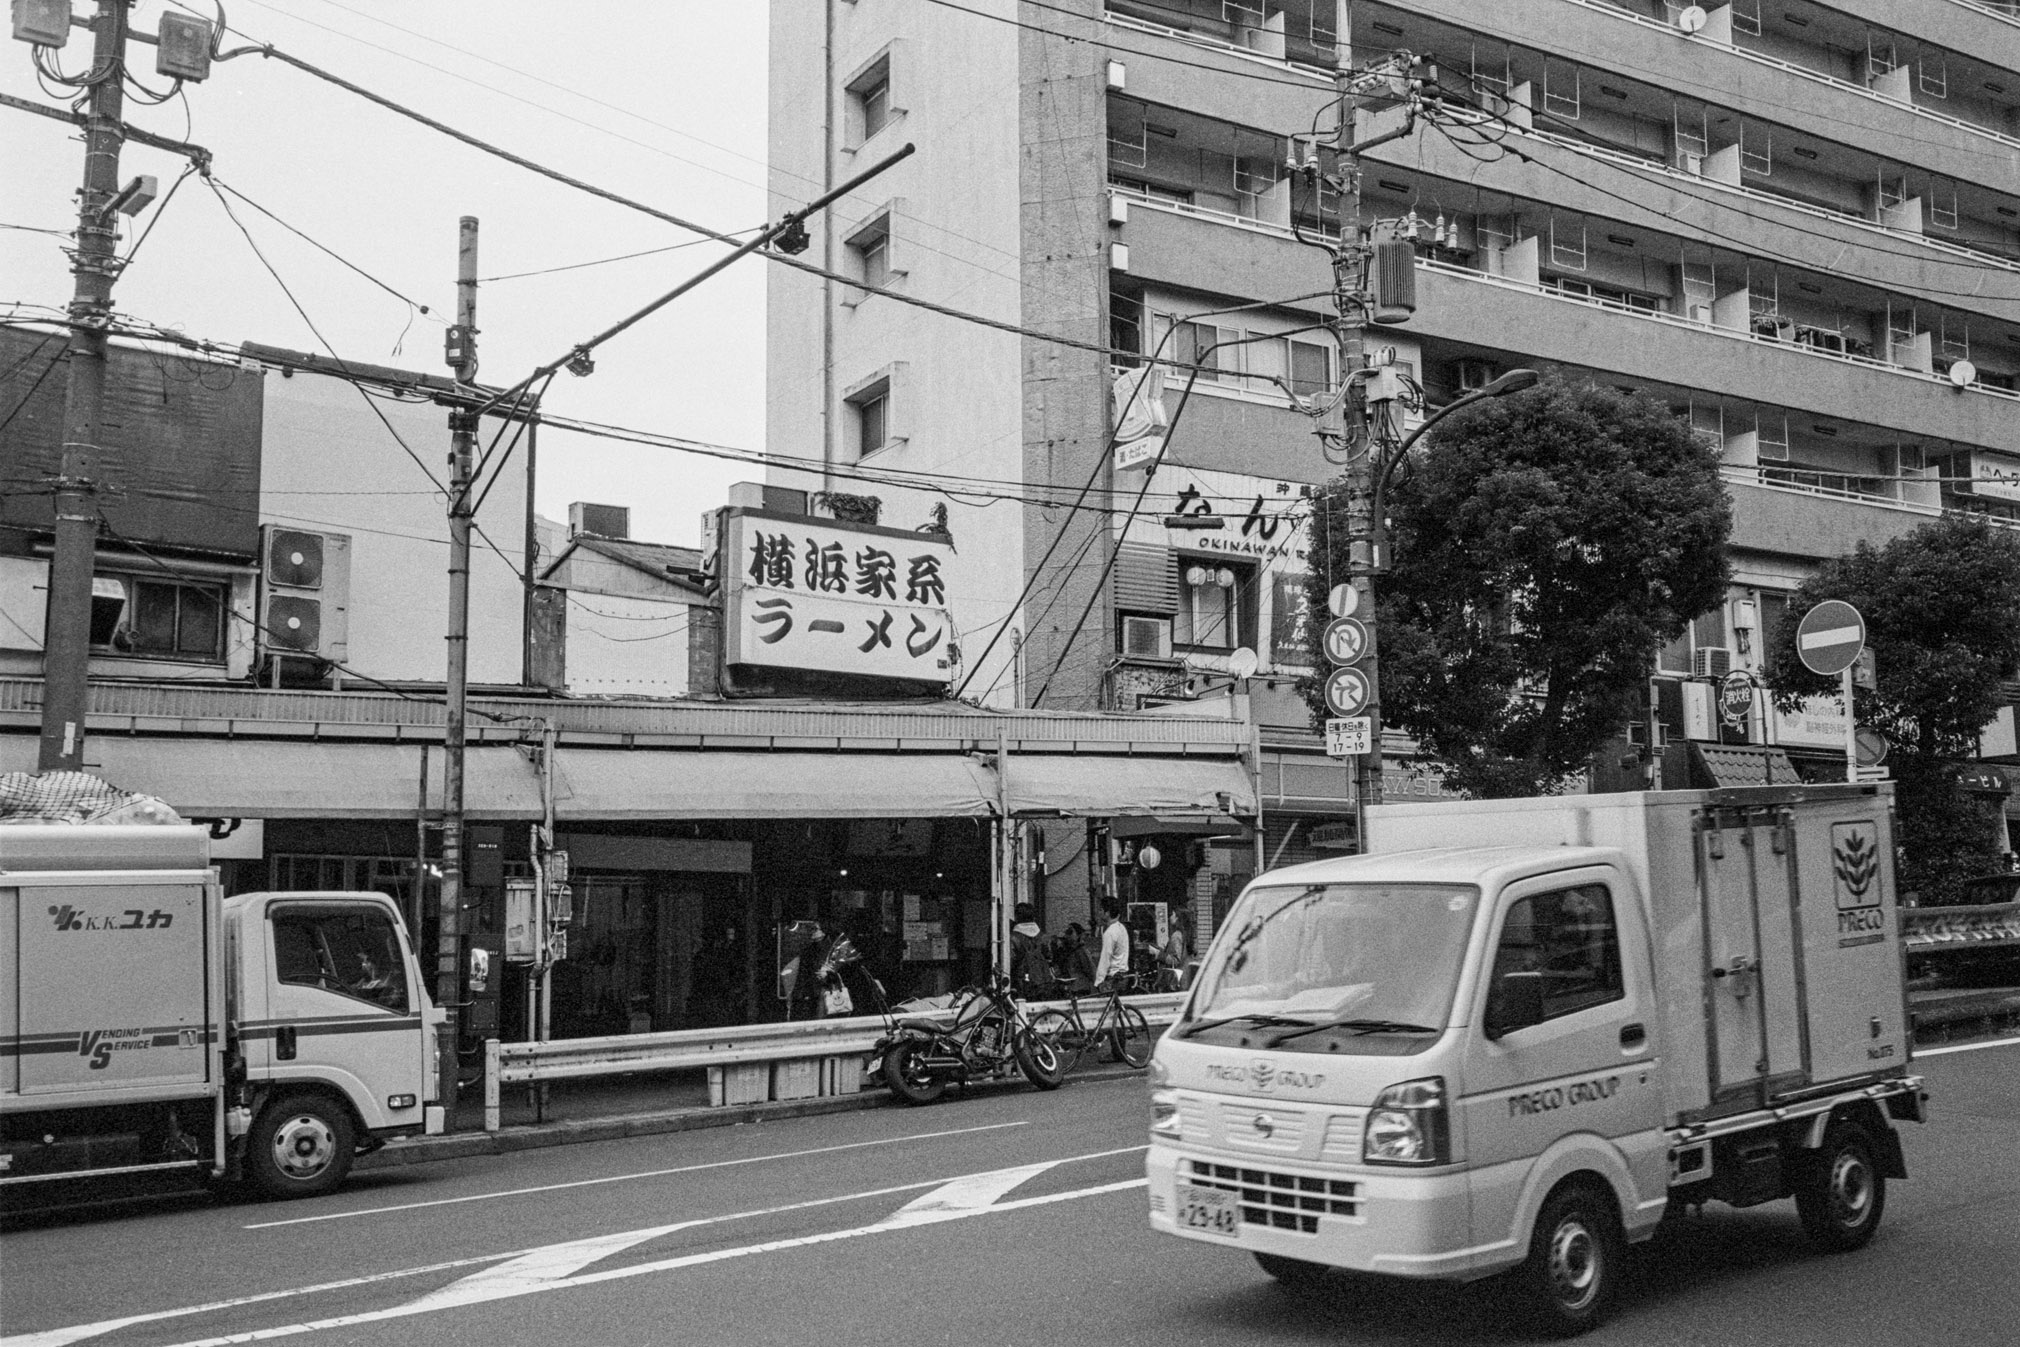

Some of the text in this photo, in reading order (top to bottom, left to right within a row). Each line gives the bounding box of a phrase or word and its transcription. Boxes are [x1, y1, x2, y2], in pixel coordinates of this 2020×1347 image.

[749, 530, 945, 605] 横浜家系
[1200, 537, 1289, 558] OKINAWAN
[751, 598, 943, 659] ラーメン
[1725, 687, 1751, 705] 消火栓
